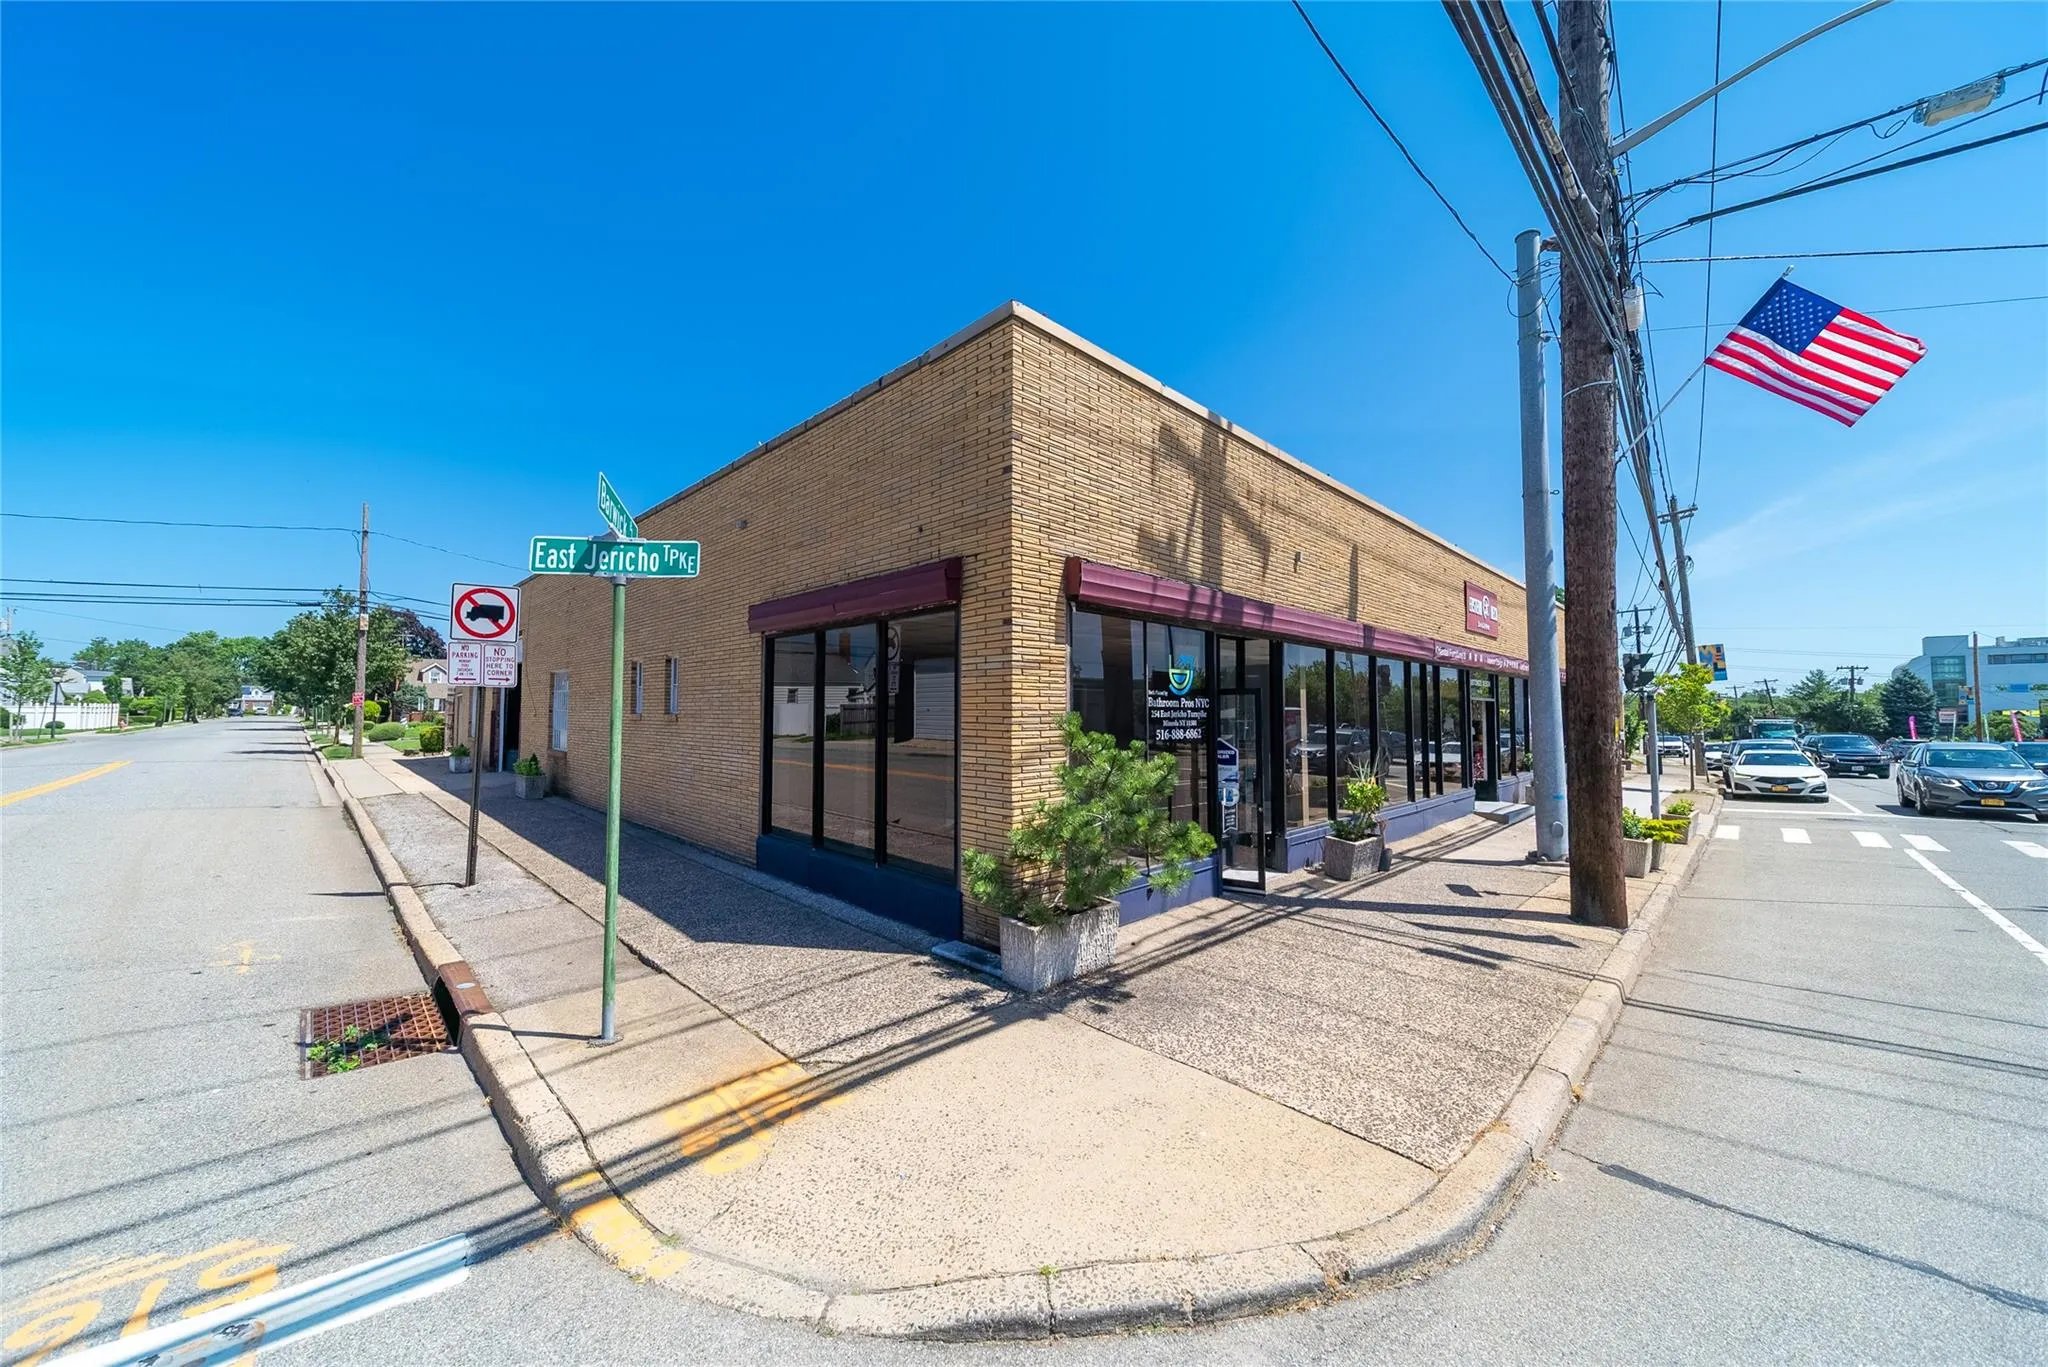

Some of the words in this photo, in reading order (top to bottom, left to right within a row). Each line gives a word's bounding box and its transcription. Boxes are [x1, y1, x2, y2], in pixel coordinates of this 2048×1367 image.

[535, 542, 576, 569] East
[584, 543, 660, 572] Jericho
[663, 544, 695, 574] TPKE
[493, 648, 507, 657] NO
[1148, 697, 1180, 708] Bathroom
[1180, 698, 1195, 708] Pros
[1195, 698, 1210, 708] NYC
[1160, 710, 1170, 718] East
[1156, 728, 1202, 740] 516-888-6862
